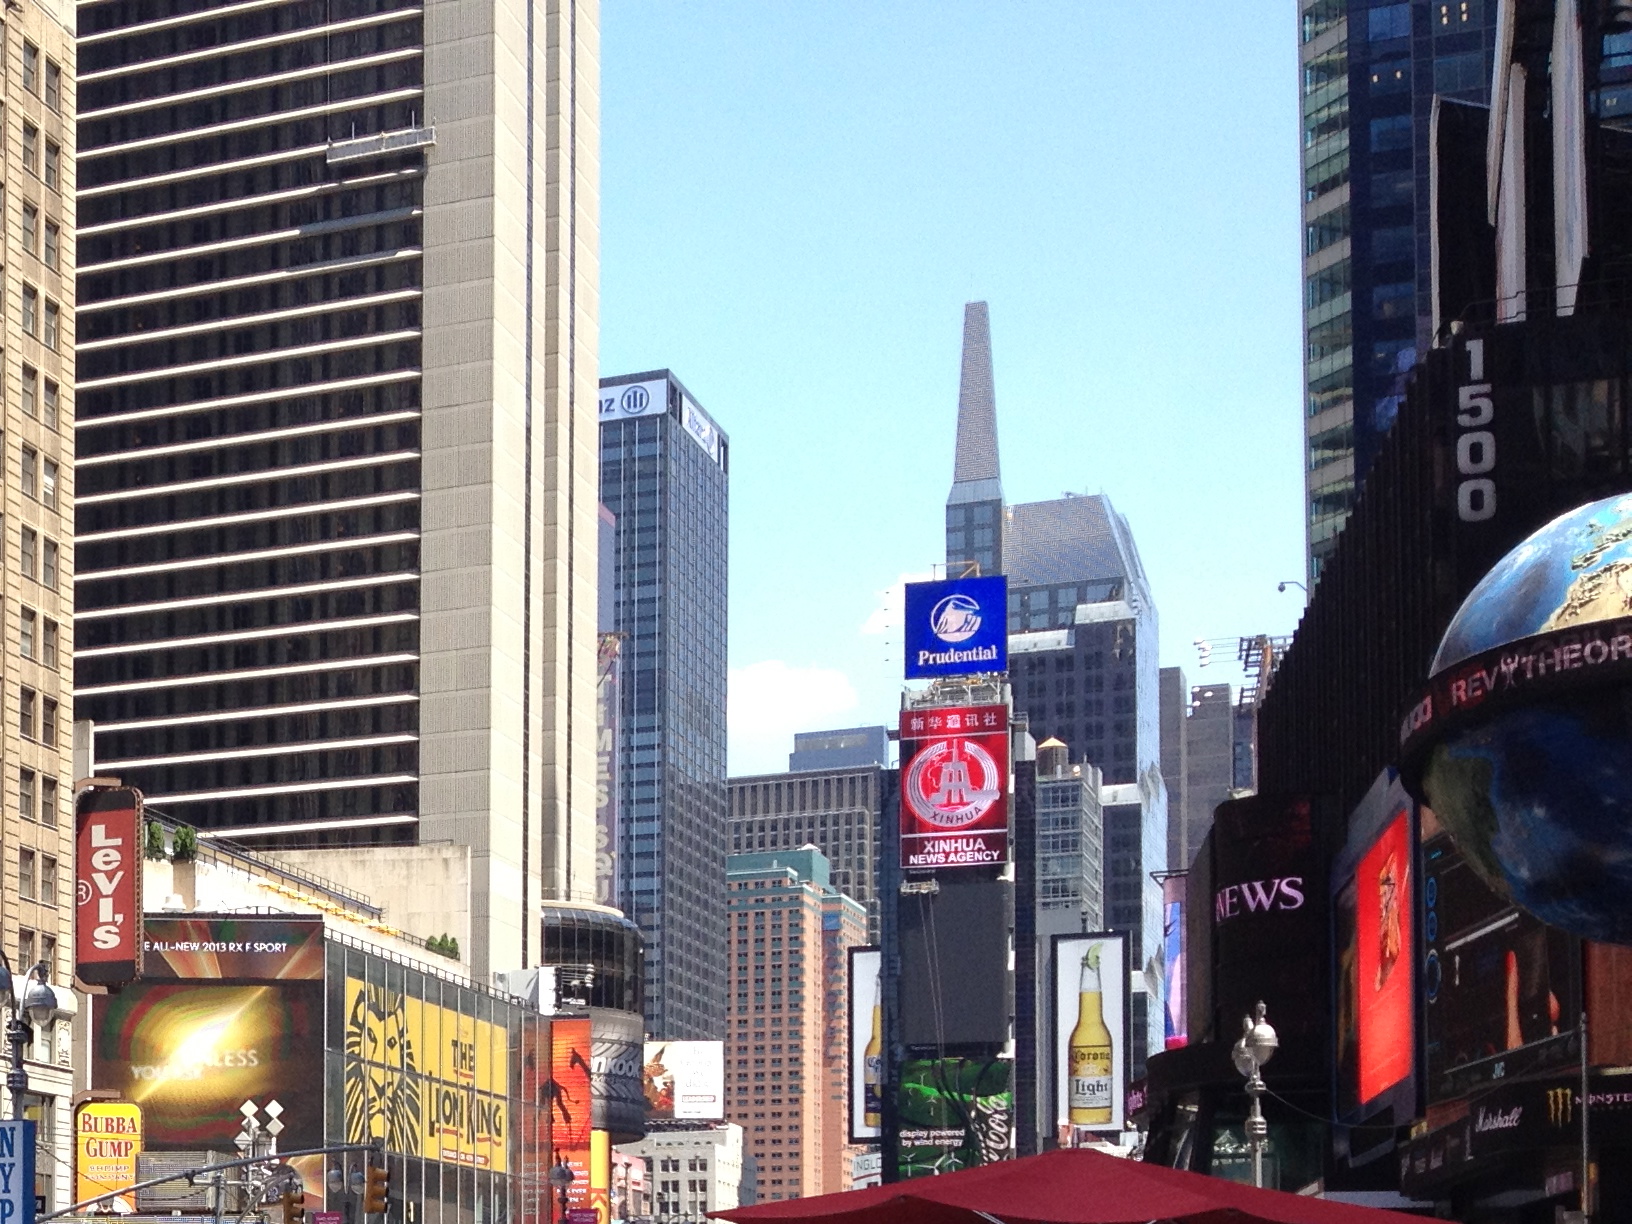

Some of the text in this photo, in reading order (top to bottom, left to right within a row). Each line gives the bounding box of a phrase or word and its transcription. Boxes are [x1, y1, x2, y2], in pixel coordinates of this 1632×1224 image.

[1456, 338, 1497, 522] 1500
[918, 645, 999, 667] Prudential
[910, 711, 998, 731] 新华通讯社
[929, 805, 983, 824] XINHUA
[924, 838, 986, 853] XINHUA
[909, 850, 1000, 864] NEWS AGENCY
[1216, 877, 1305, 922] NEWS
[203, 942, 226, 952] 2013
[229, 942, 243, 952] RX
[245, 943, 251, 952] F
[253, 943, 287, 953] SPORT
[452, 1039, 474, 1072] THE
[1074, 1079, 1108, 1096] Light
[428, 1070, 502, 1145] LION KING
[81, 1113, 137, 1133] BUBBA
[1475, 1106, 1523, 1132] Marshall
[85, 1137, 134, 1158] GUMP
